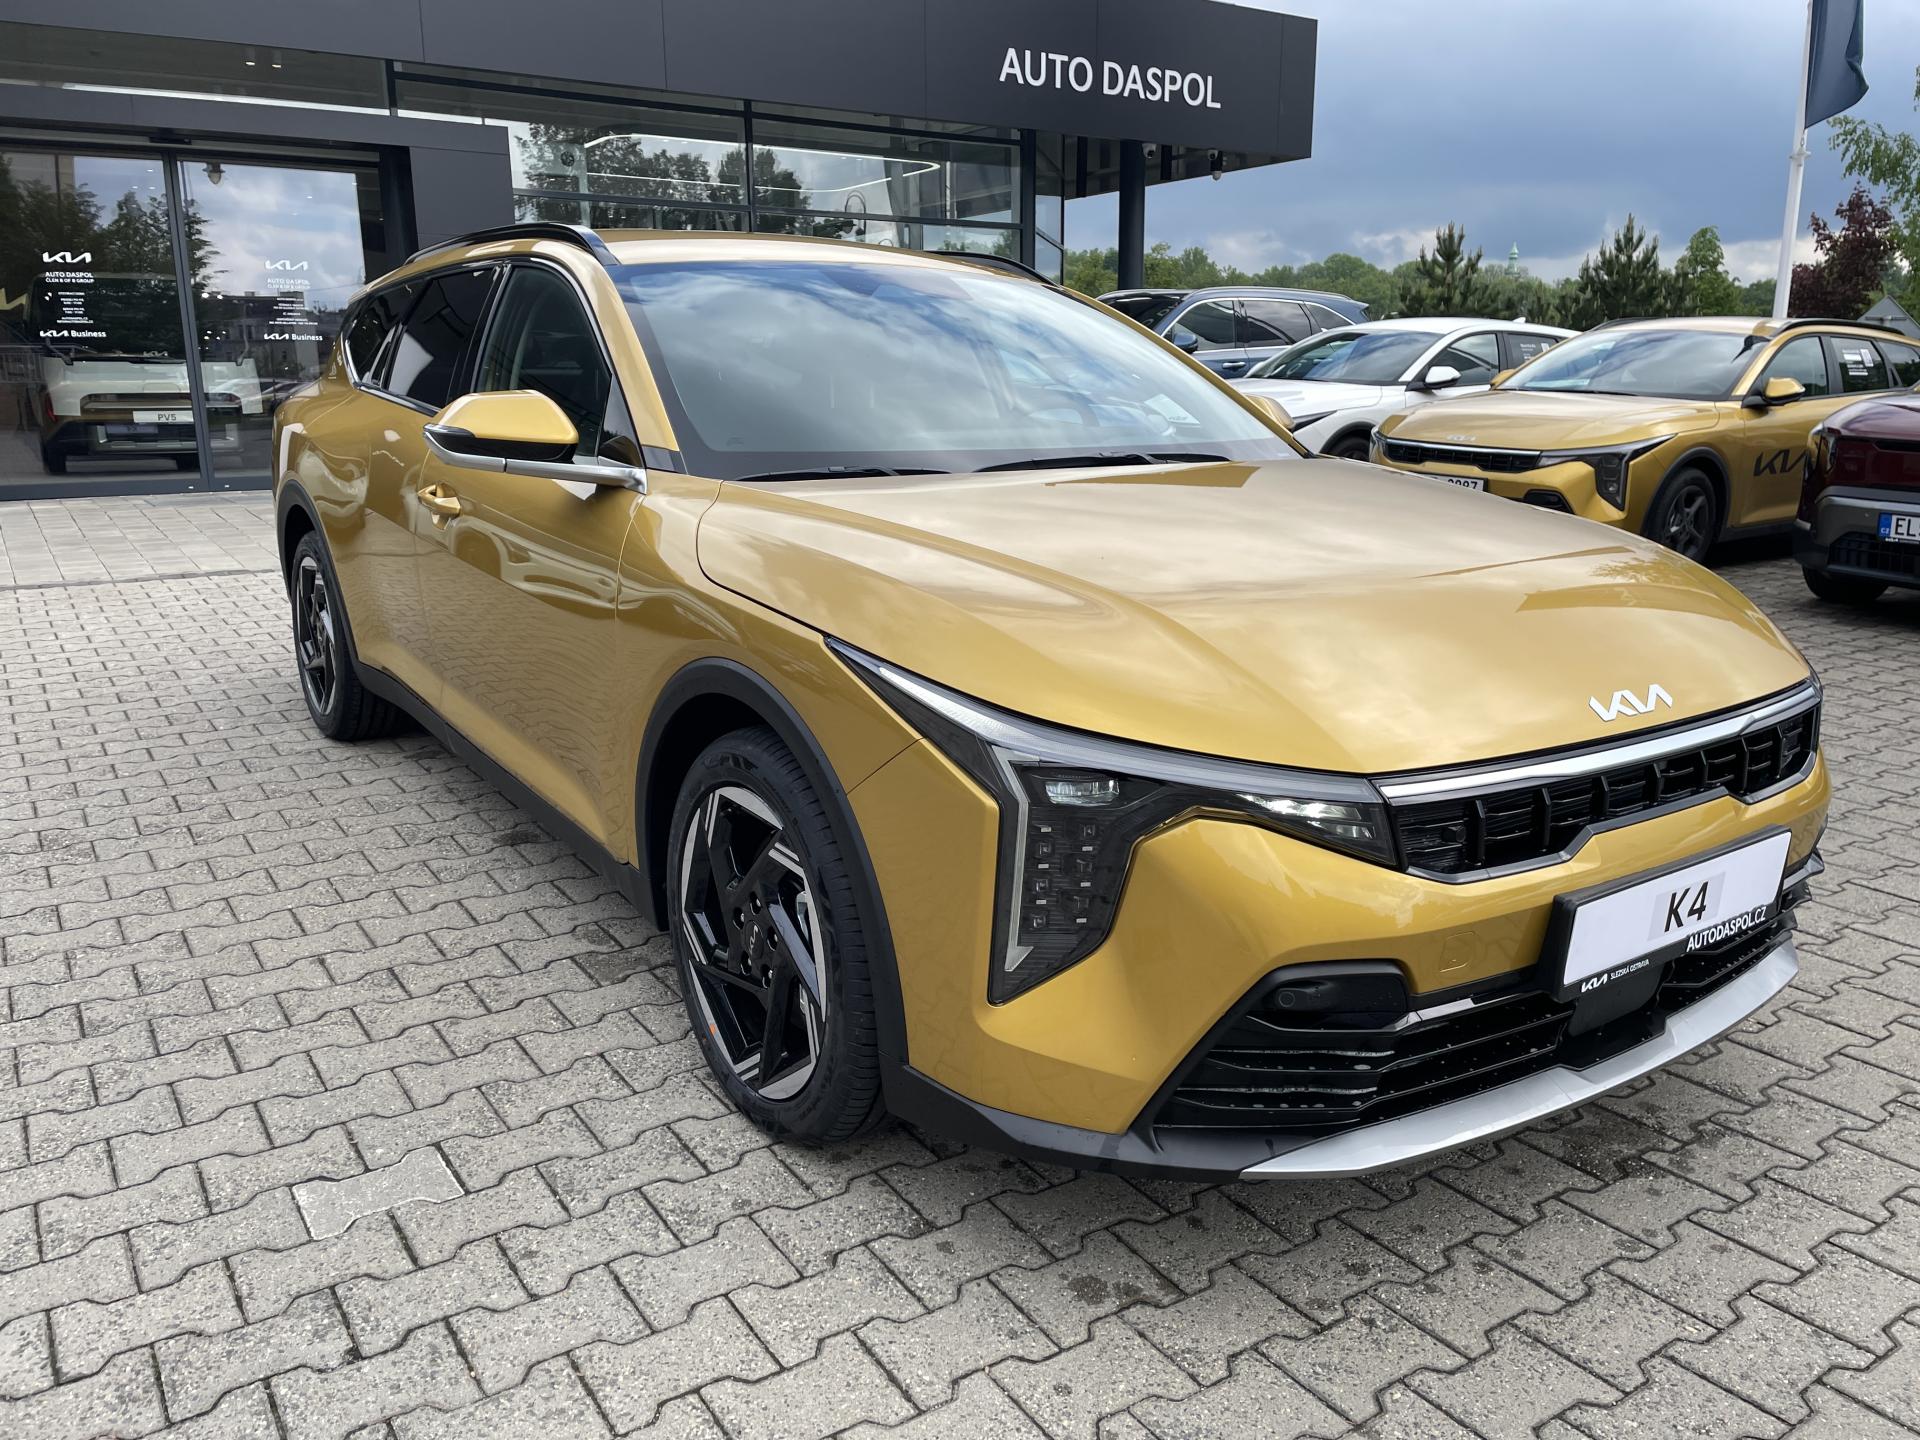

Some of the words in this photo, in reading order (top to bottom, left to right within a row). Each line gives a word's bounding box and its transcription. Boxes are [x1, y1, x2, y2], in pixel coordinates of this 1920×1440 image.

[999, 47, 1093, 92] AUTO
[1102, 60, 1221, 109] DASPOL
[42, 252, 92, 263] KIA
[265, 260, 309, 271] KIA
[291, 333, 323, 341] Business
[157, 413, 177, 421] PV5
[1895, 517, 1920, 537] EL
[1588, 684, 1674, 722] KIA
[1664, 881, 1709, 933] K4
[1686, 906, 1767, 953] AUTODASPOL.CZ
[1580, 973, 1608, 993] KIA
[1610, 965, 1630, 980] SLEZSKÁ
[1629, 958, 1650, 972] OSTRAVA
